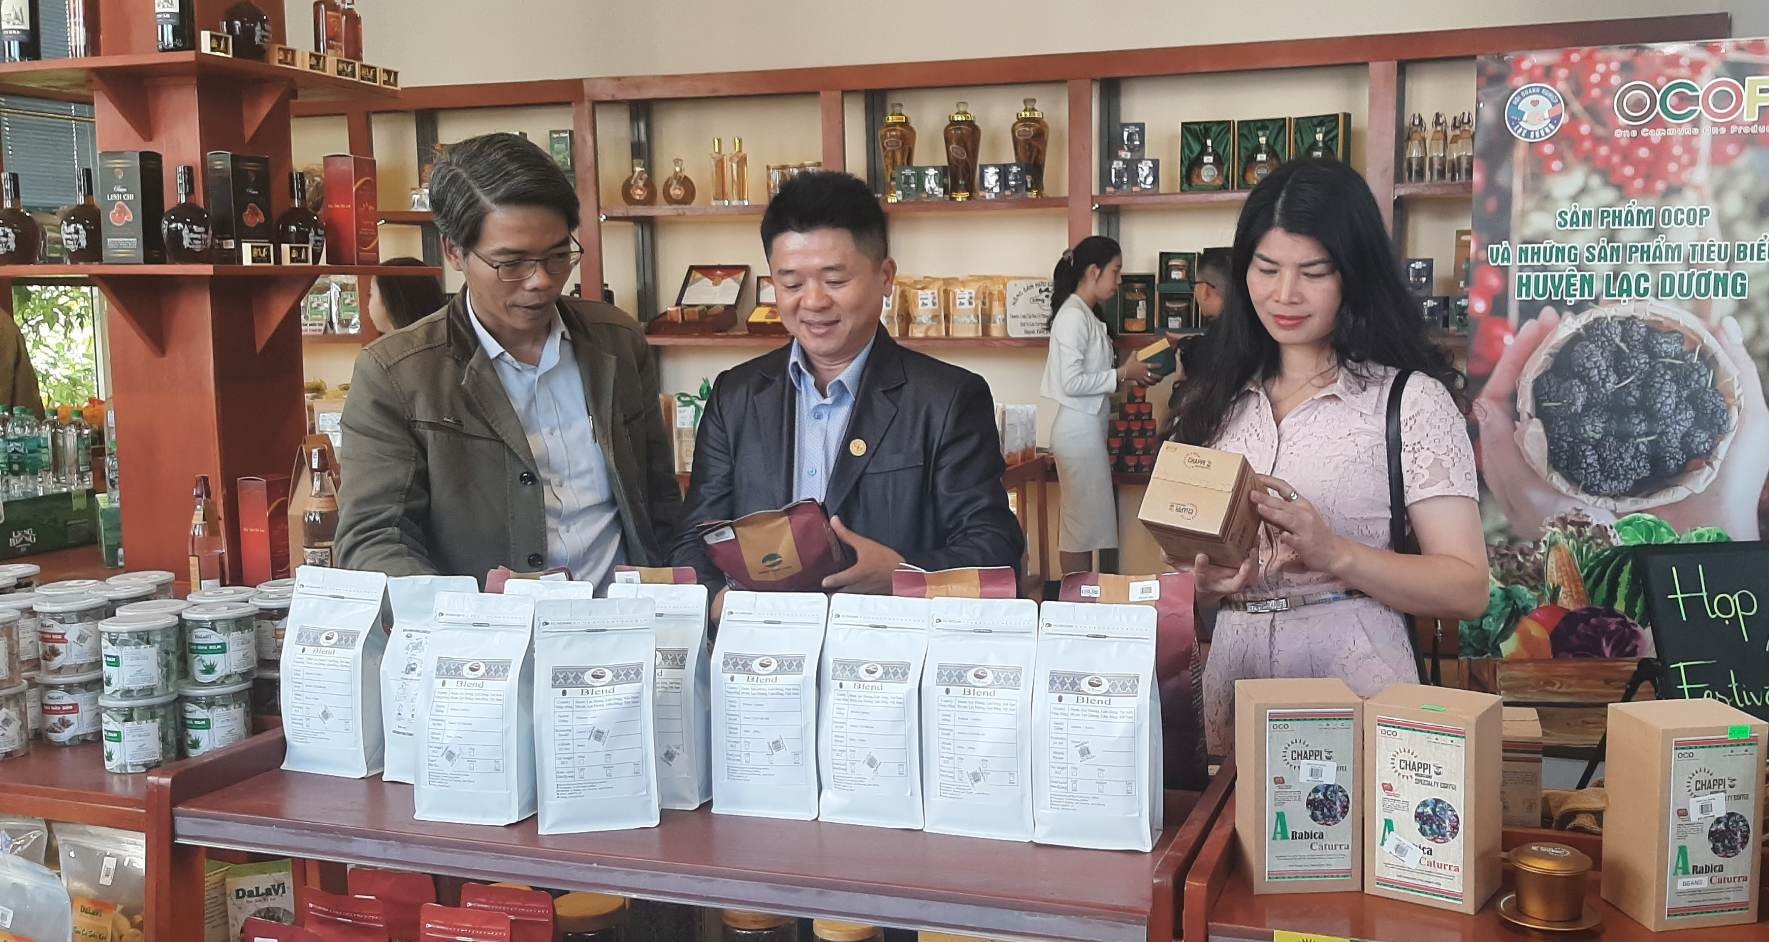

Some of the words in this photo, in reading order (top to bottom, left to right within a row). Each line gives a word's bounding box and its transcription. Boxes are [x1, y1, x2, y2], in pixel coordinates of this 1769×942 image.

[1614, 76, 1769, 125] OCOP
[1614, 128, 1638, 138] One
[1641, 127, 1700, 137] Commune
[1556, 204, 1593, 229] SẢN
[1600, 200, 1655, 228] PHẨM
[1661, 207, 1711, 227] OCOP
[1488, 242, 1511, 265] VÀ
[1518, 241, 1579, 264] NHỮNG
[1585, 238, 1621, 263] SẢN
[1627, 235, 1682, 262] PHẨM
[1689, 239, 1729, 262] TIÊU
[1735, 233, 1769, 263] BIỂ
[1516, 268, 1595, 305] HUYỆN
[1604, 272, 1650, 305] LẠC
[1659, 270, 1748, 299] DƯƠNG
[1667, 563, 1758, 642] Họp
[455, 680, 485, 689] Blend
[746, 675, 778, 684] Blend
[580, 687, 616, 696] Blend
[853, 683, 884, 691] Blend
[962, 687, 996, 697] Blend
[1075, 695, 1112, 705] Blend
[1291, 749, 1323, 761] CHAPPI
[1399, 759, 1431, 775] CHAPPI
[1694, 778, 1726, 791] CHAPPI
[1309, 841, 1350, 852] Caturra
[1419, 856, 1460, 873] Caturra
[1709, 875, 1748, 886] Caturra
[235, 882, 287, 900] DaLaVi
